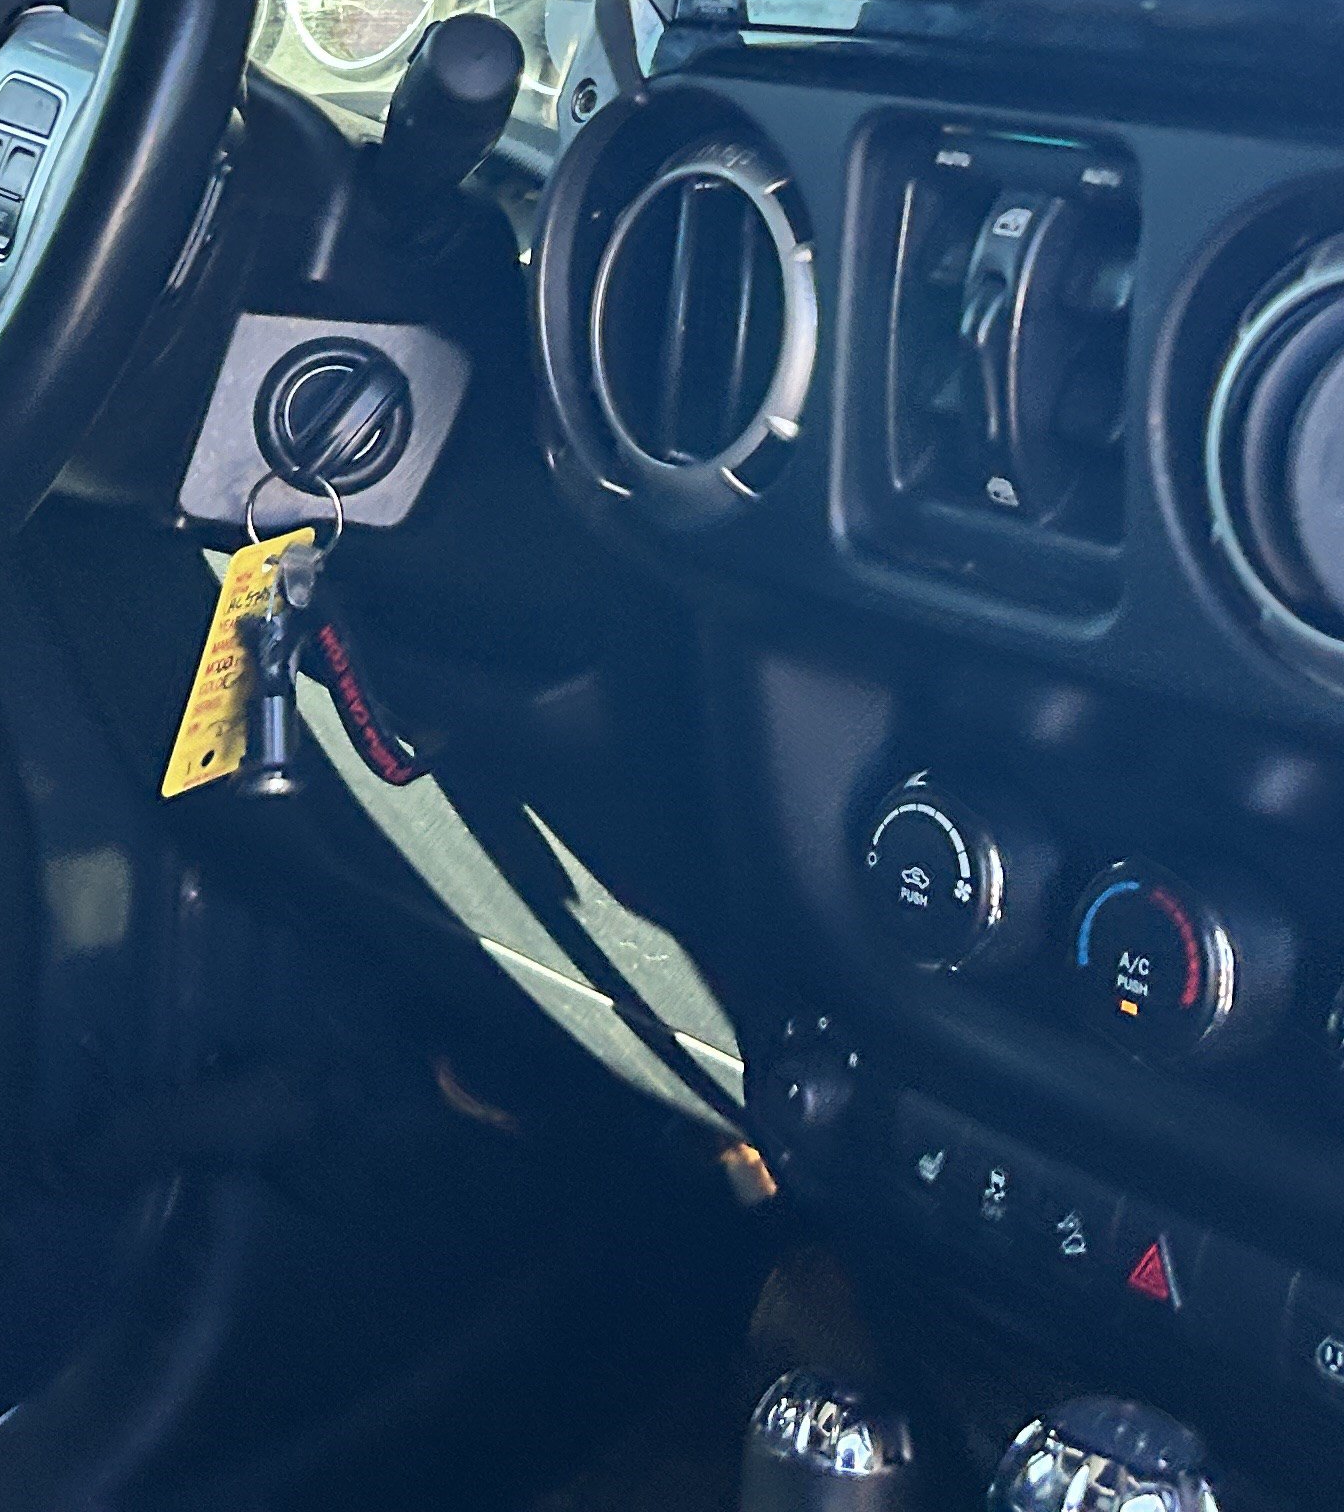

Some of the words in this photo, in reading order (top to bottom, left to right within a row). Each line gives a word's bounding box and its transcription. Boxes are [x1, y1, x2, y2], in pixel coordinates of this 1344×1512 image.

[900, 886, 929, 907] PUSH
[1118, 951, 1150, 976] A/C
[1117, 974, 1149, 997] PUSH
